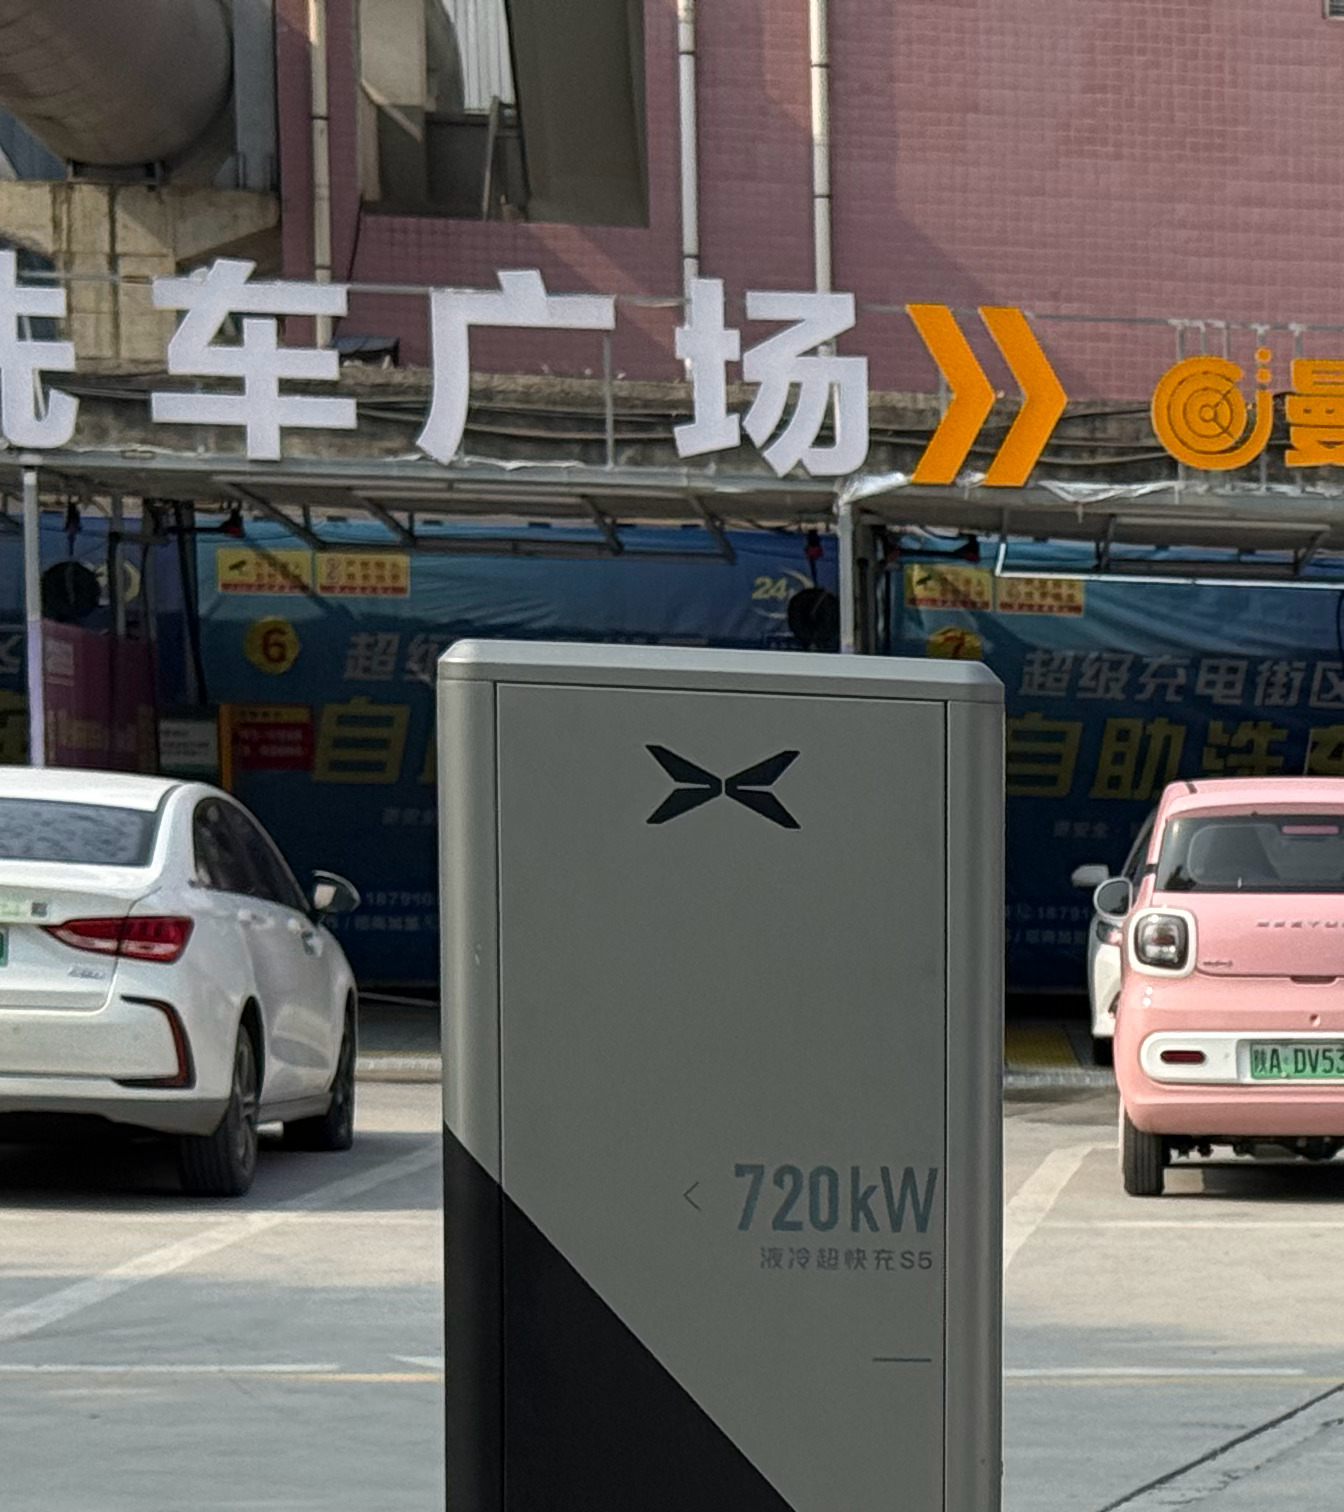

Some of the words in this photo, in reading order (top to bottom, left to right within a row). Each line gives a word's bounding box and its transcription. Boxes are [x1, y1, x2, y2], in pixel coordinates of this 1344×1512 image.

[262, 627, 288, 664] 6
[734, 1162, 939, 1233] 720kW
[760, 1246, 933, 1272] 液冷超快充S5
